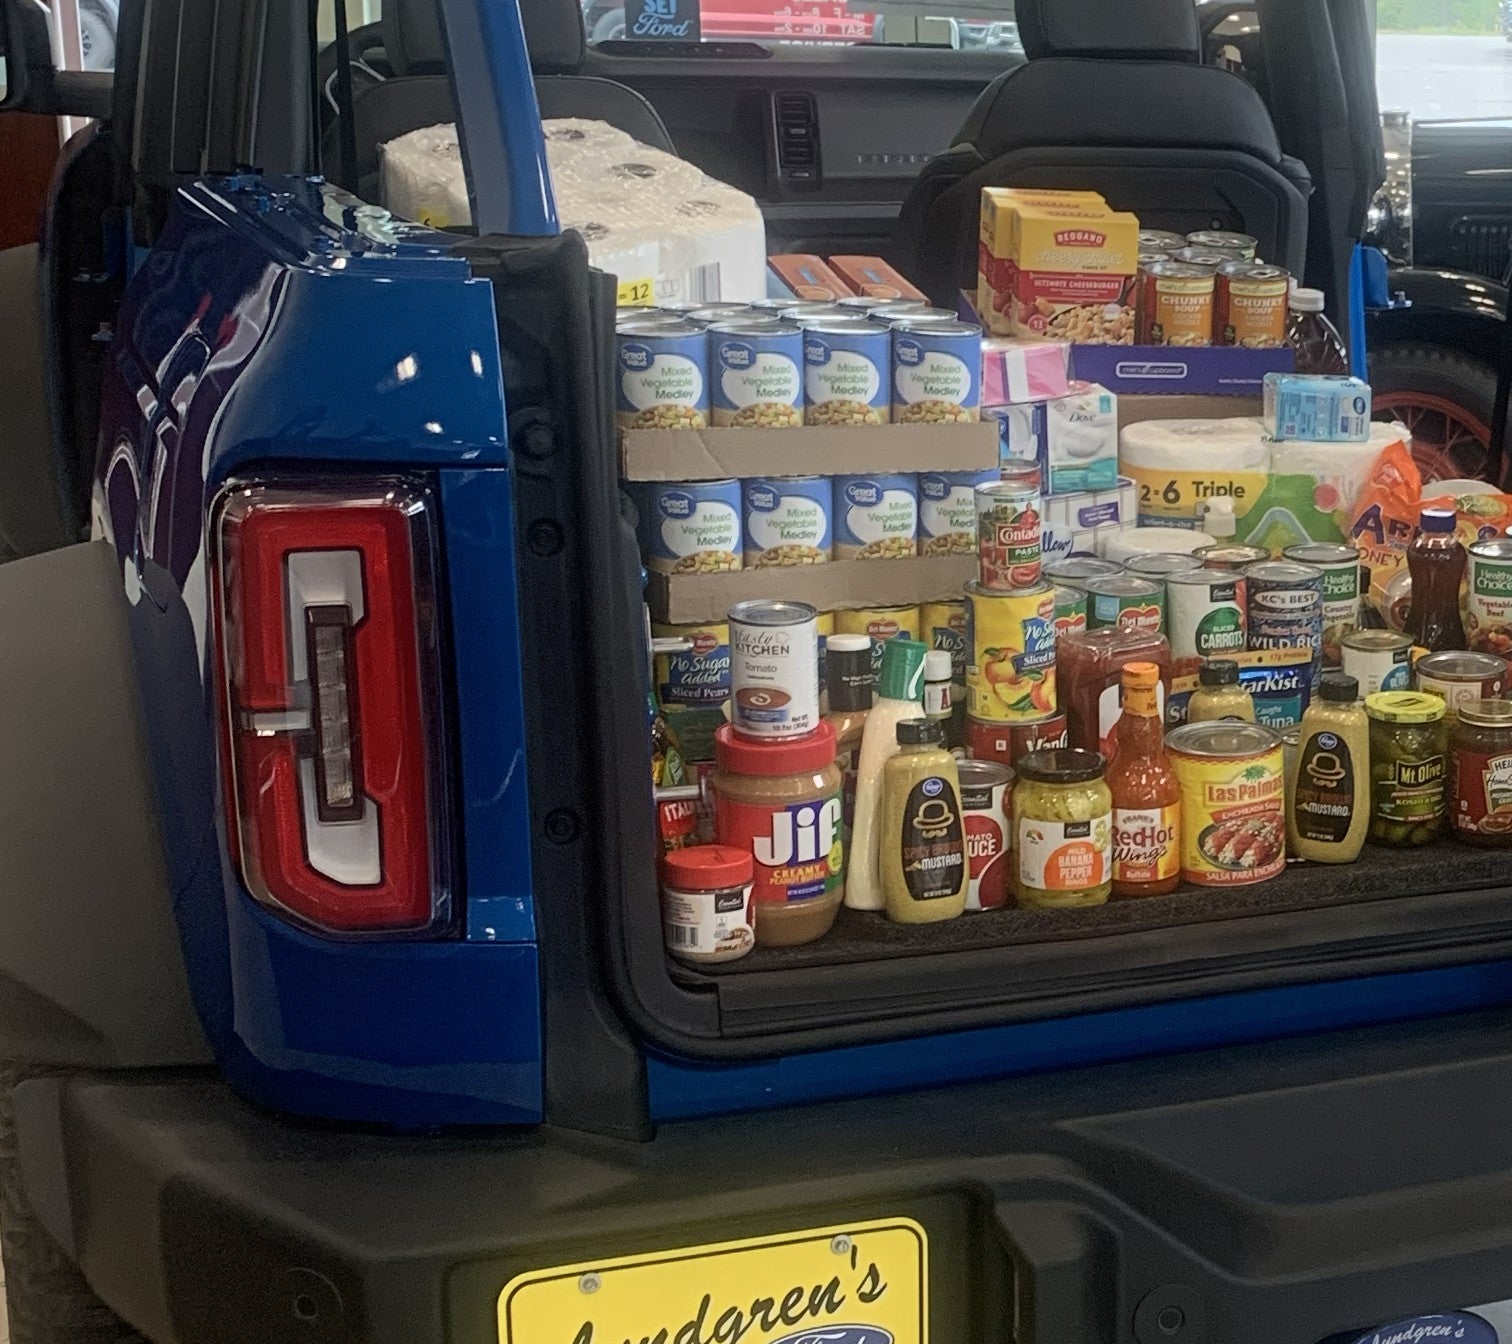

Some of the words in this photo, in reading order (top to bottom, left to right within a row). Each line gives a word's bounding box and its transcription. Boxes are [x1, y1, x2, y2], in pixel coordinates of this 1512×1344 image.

[633, 13, 690, 37] Ford
[631, 284, 650, 301] 12
[655, 389, 694, 400] Medley
[756, 387, 792, 398] Medley
[830, 385, 869, 396] Medley
[923, 385, 962, 397] Medley
[957, 498, 975, 507] Mix
[697, 535, 733, 546] Medley
[780, 529, 818, 540] Medley
[1290, 594, 1315, 604] BEST
[1201, 631, 1243, 649] CARROTS
[1249, 636, 1291, 649] WILD
[1296, 635, 1322, 649] RIC
[735, 644, 790, 656] KITCHEN
[671, 656, 690, 671] No
[1241, 676, 1300, 693] tarKist
[671, 687, 701, 698] Sliced
[703, 687, 730, 698] Pears
[1418, 762, 1443, 783] Olive
[1208, 784, 1237, 802] Las
[1308, 802, 1350, 817] MUSTARD
[753, 798, 842, 866] Jif
[967, 832, 993, 841] MATO
[968, 838, 997, 858] UCE
[922, 852, 963, 870] MUSTARD
[1059, 854, 1094, 867] BANANA
[1112, 845, 1168, 866] Wings
[772, 865, 822, 879] CREAMY
[1059, 866, 1093, 879] PEPPER
